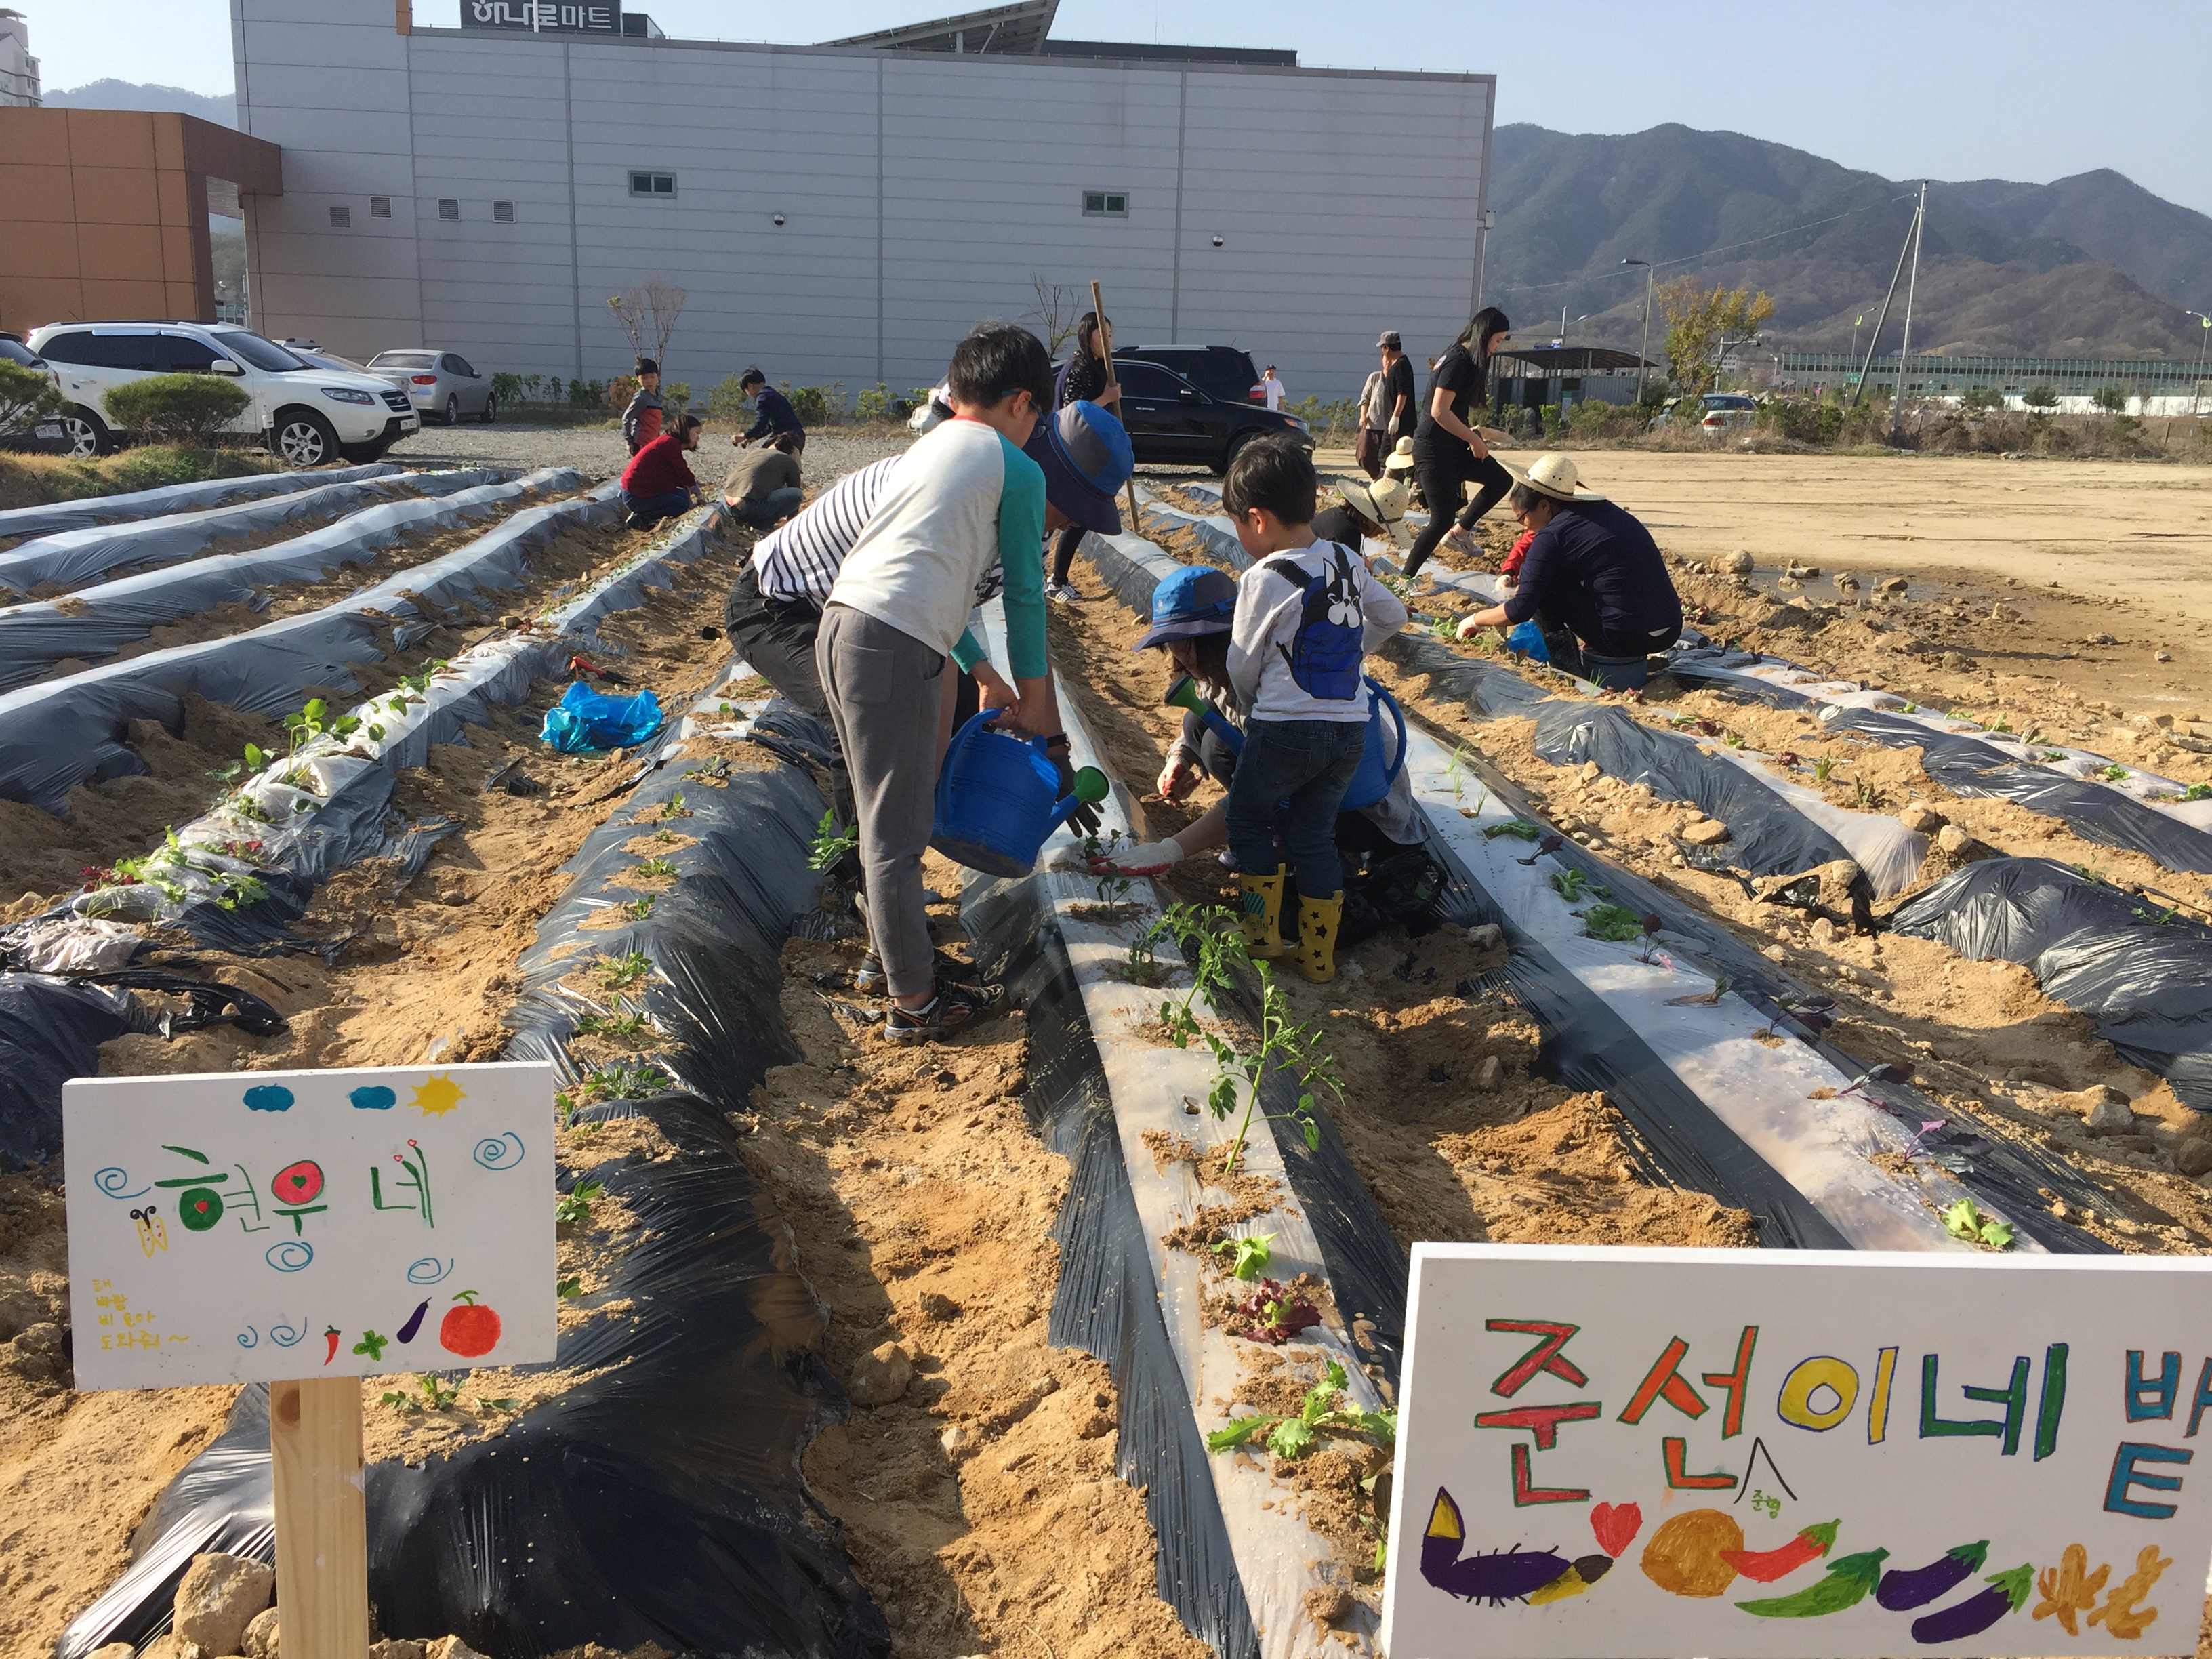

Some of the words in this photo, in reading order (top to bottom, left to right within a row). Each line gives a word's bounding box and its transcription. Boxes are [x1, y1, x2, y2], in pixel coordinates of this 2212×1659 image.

[471, 0, 612, 28] 하나로마트
[98, 1313, 113, 1326] 비
[1474, 1319, 2069, 1507] 준선이네
[2103, 1349, 2212, 1519] 밭
